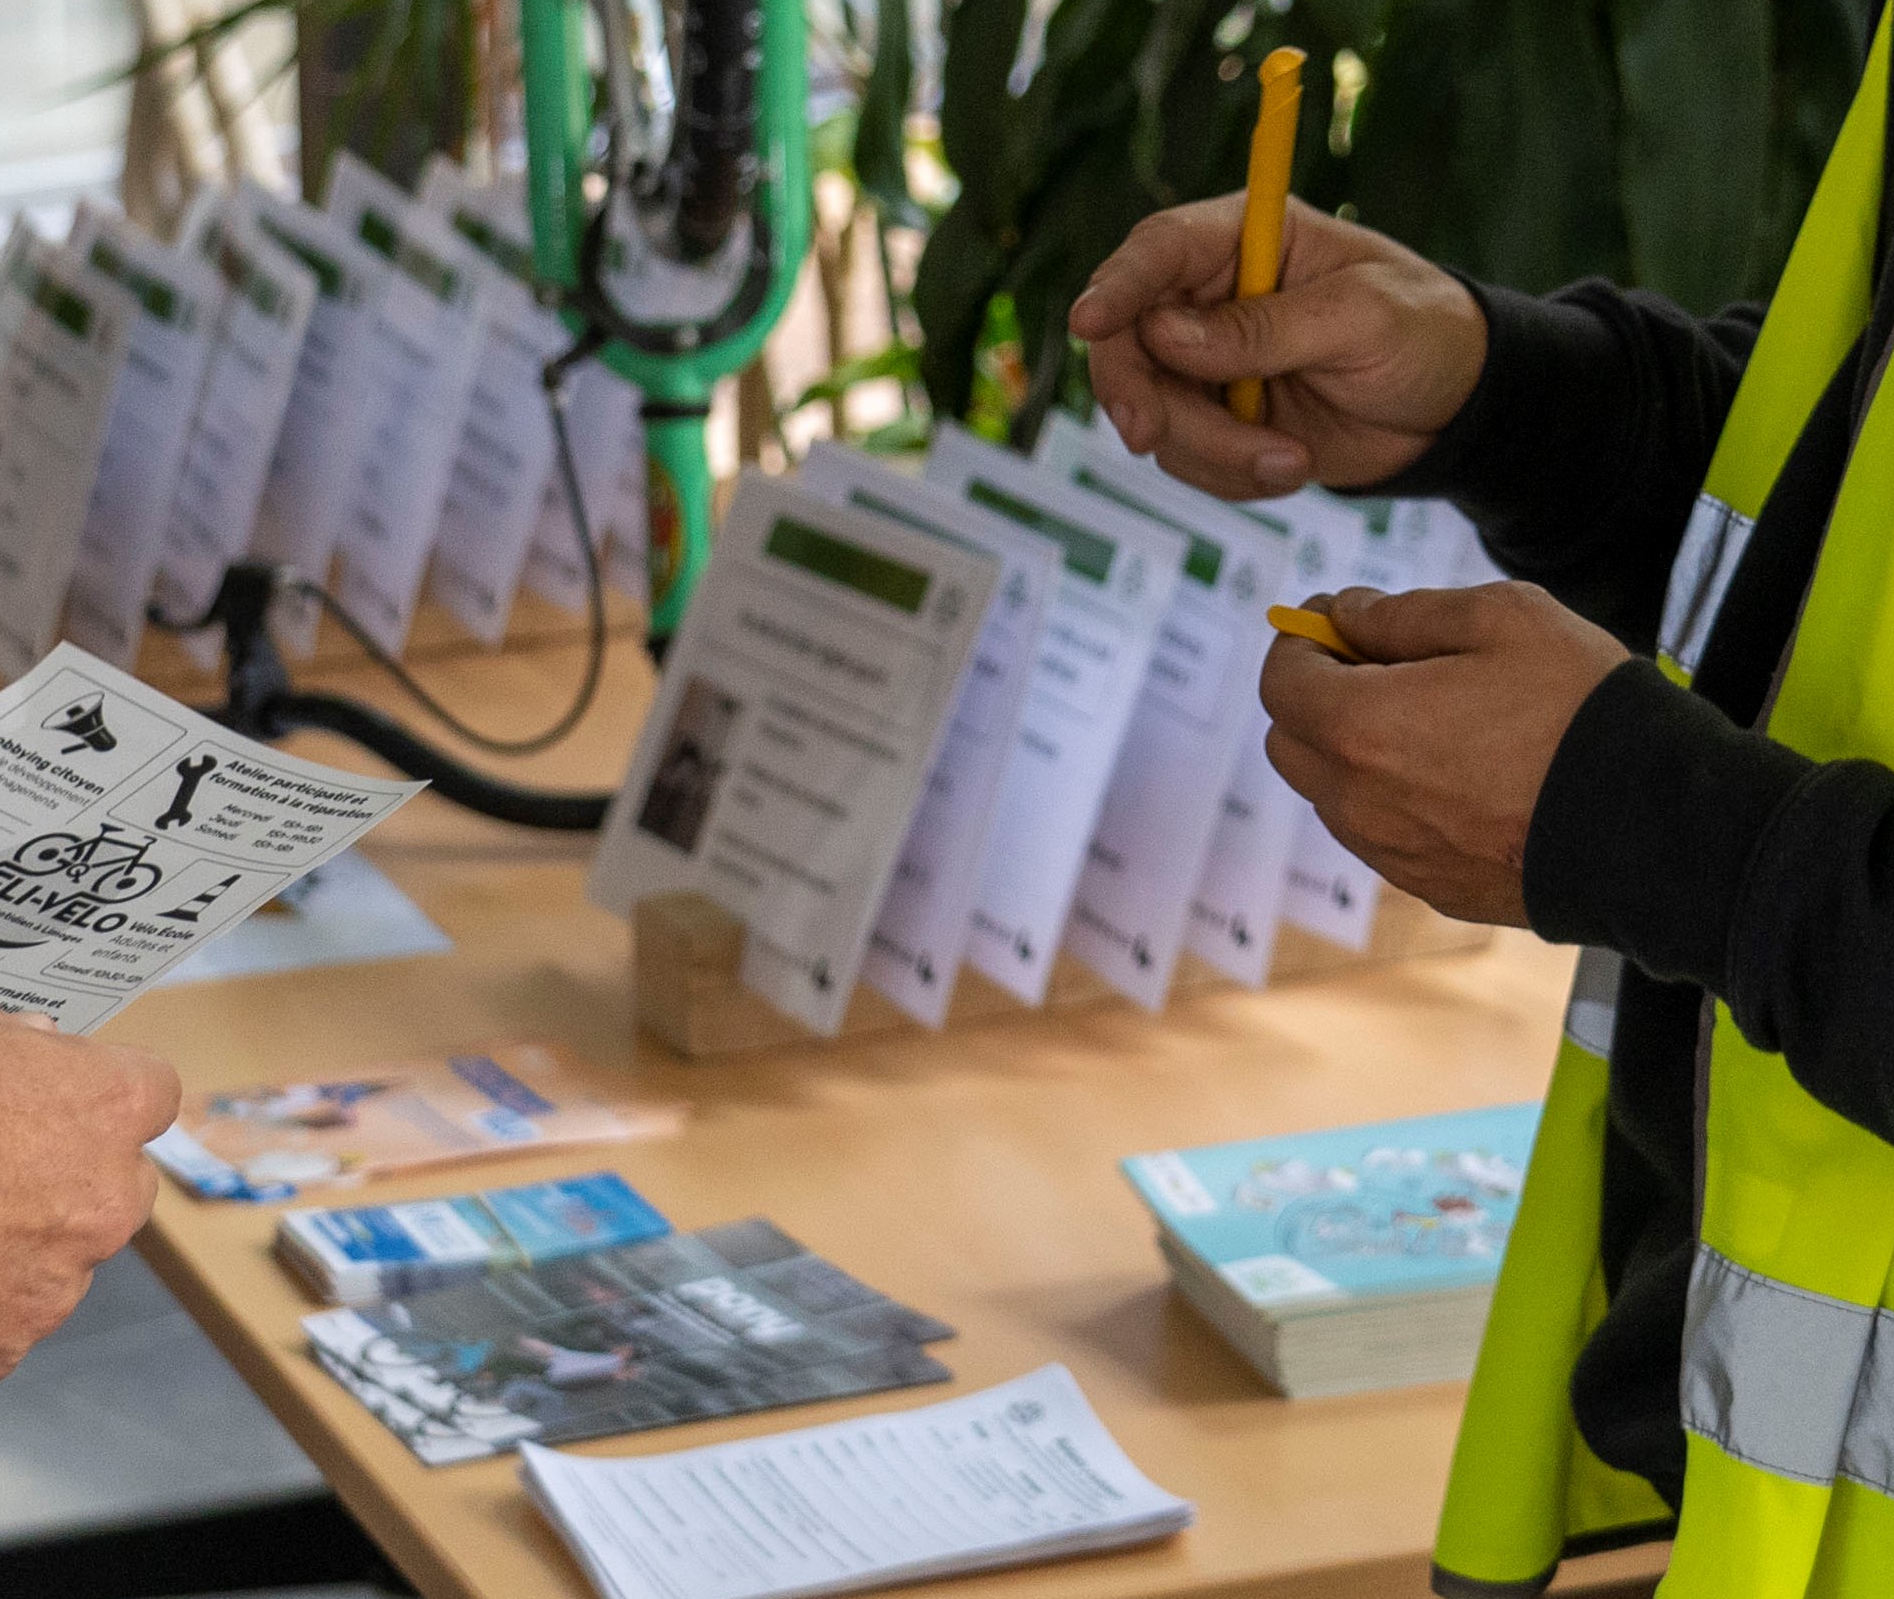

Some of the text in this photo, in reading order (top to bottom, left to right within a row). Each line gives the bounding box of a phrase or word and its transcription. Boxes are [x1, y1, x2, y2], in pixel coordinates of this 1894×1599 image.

[7, 763, 92, 807] développement
[50, 766, 105, 796] citoyen
[225, 760, 369, 806] Atelier participatif et
[209, 772, 373, 819] formation à la réparation
[209, 813, 245, 828] Jeudi
[223, 803, 275, 822] Mercredi
[194, 823, 241, 841] Samedi
[32, 922, 43, 931] à
[40, 925, 83, 943] Limoges
[128, 921, 158, 935] Vélo
[108, 934, 175, 953] Adultes et
[91, 949, 142, 964] enfants
[53, 961, 95, 976] Samedi
[47, 998, 67, 1008] et
